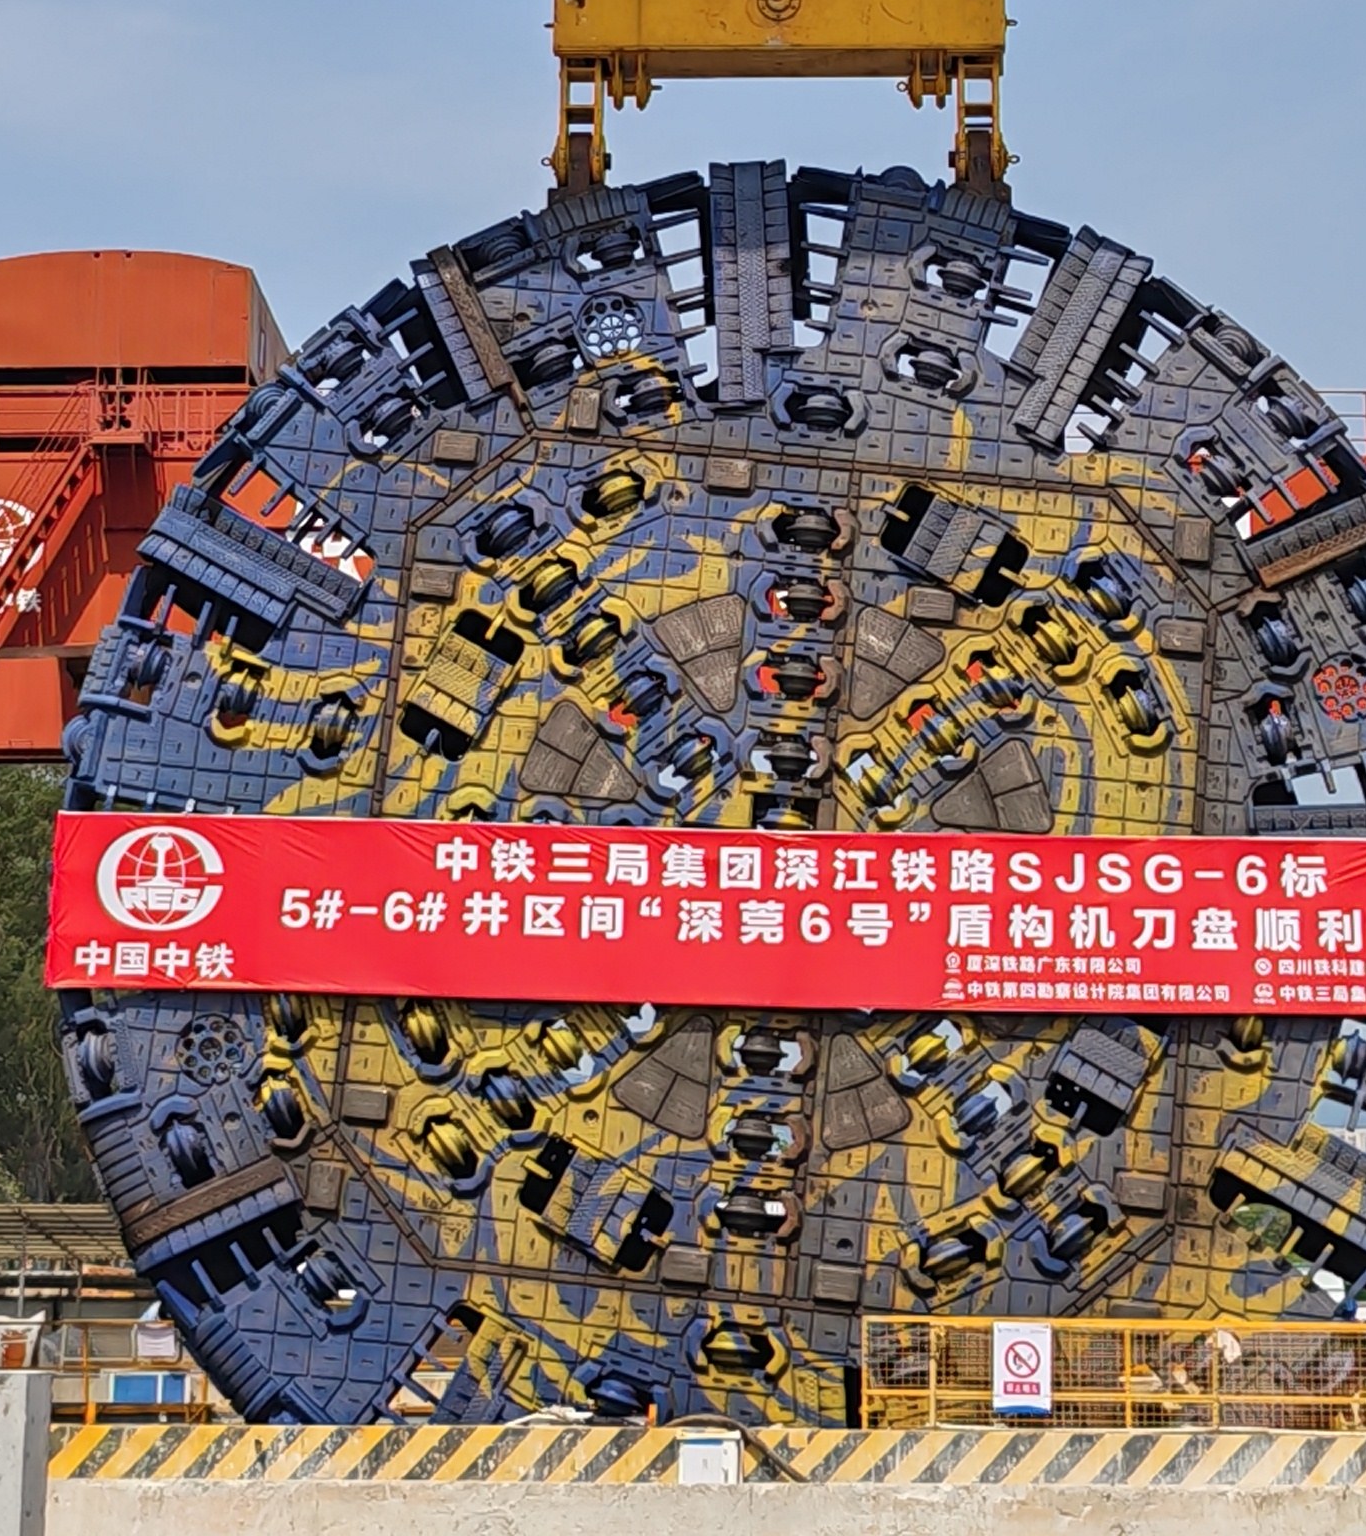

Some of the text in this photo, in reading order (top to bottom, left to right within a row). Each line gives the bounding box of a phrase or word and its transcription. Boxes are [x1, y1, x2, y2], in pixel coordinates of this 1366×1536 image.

[435, 836, 1329, 899] 中铁三局集团深江铁路SJSG-6标
[75, 940, 235, 979] 中国中铁
